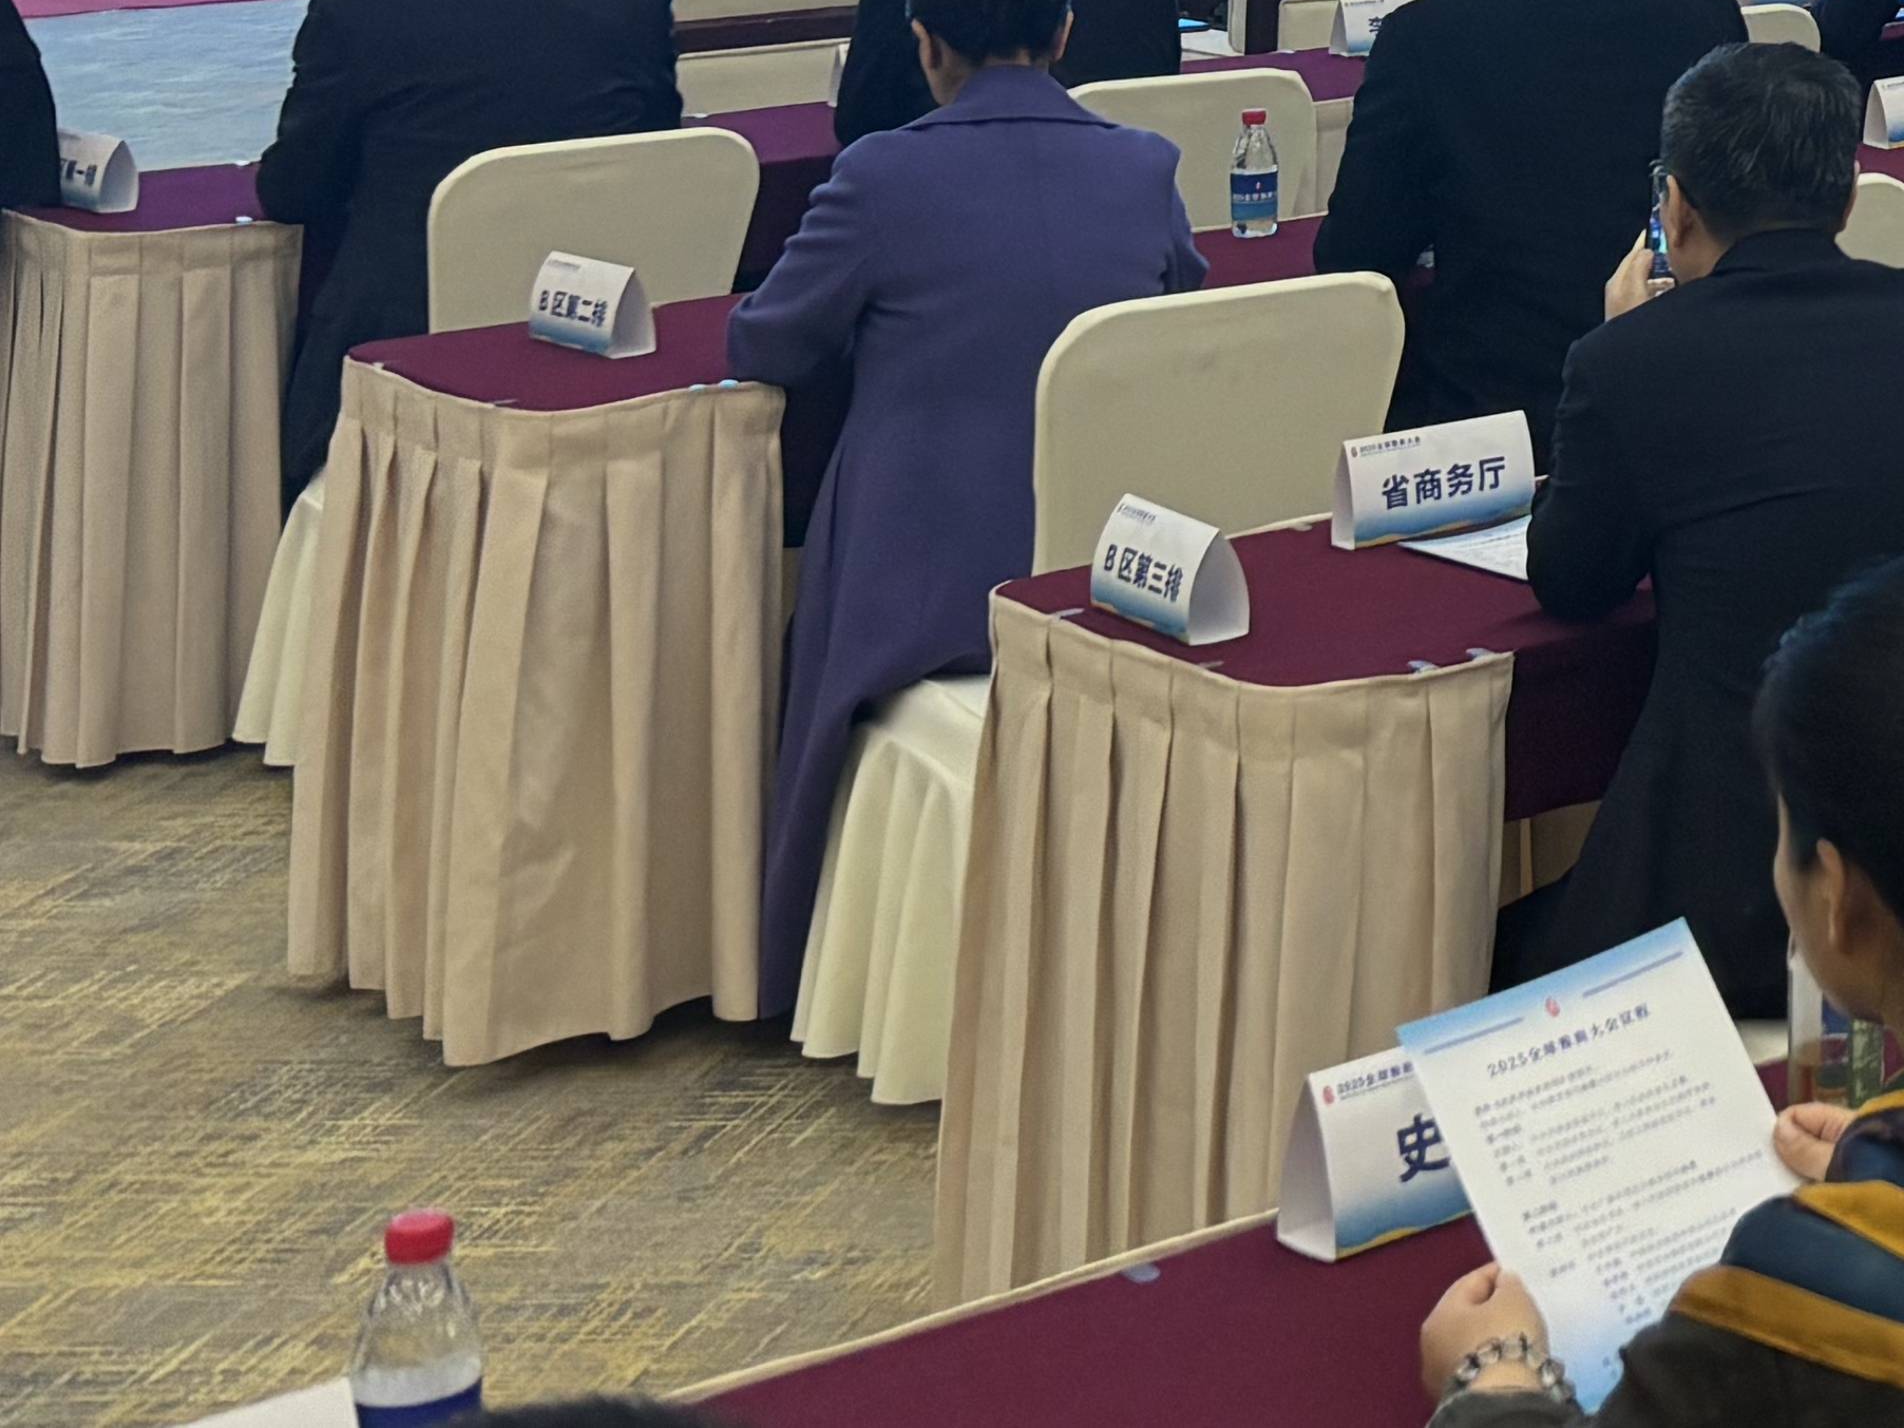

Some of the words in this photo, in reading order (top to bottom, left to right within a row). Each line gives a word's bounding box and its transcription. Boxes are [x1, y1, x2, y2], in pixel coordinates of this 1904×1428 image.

[1381, 455, 1507, 511] 省商务厅
[1103, 542, 1184, 603] B区第三排
